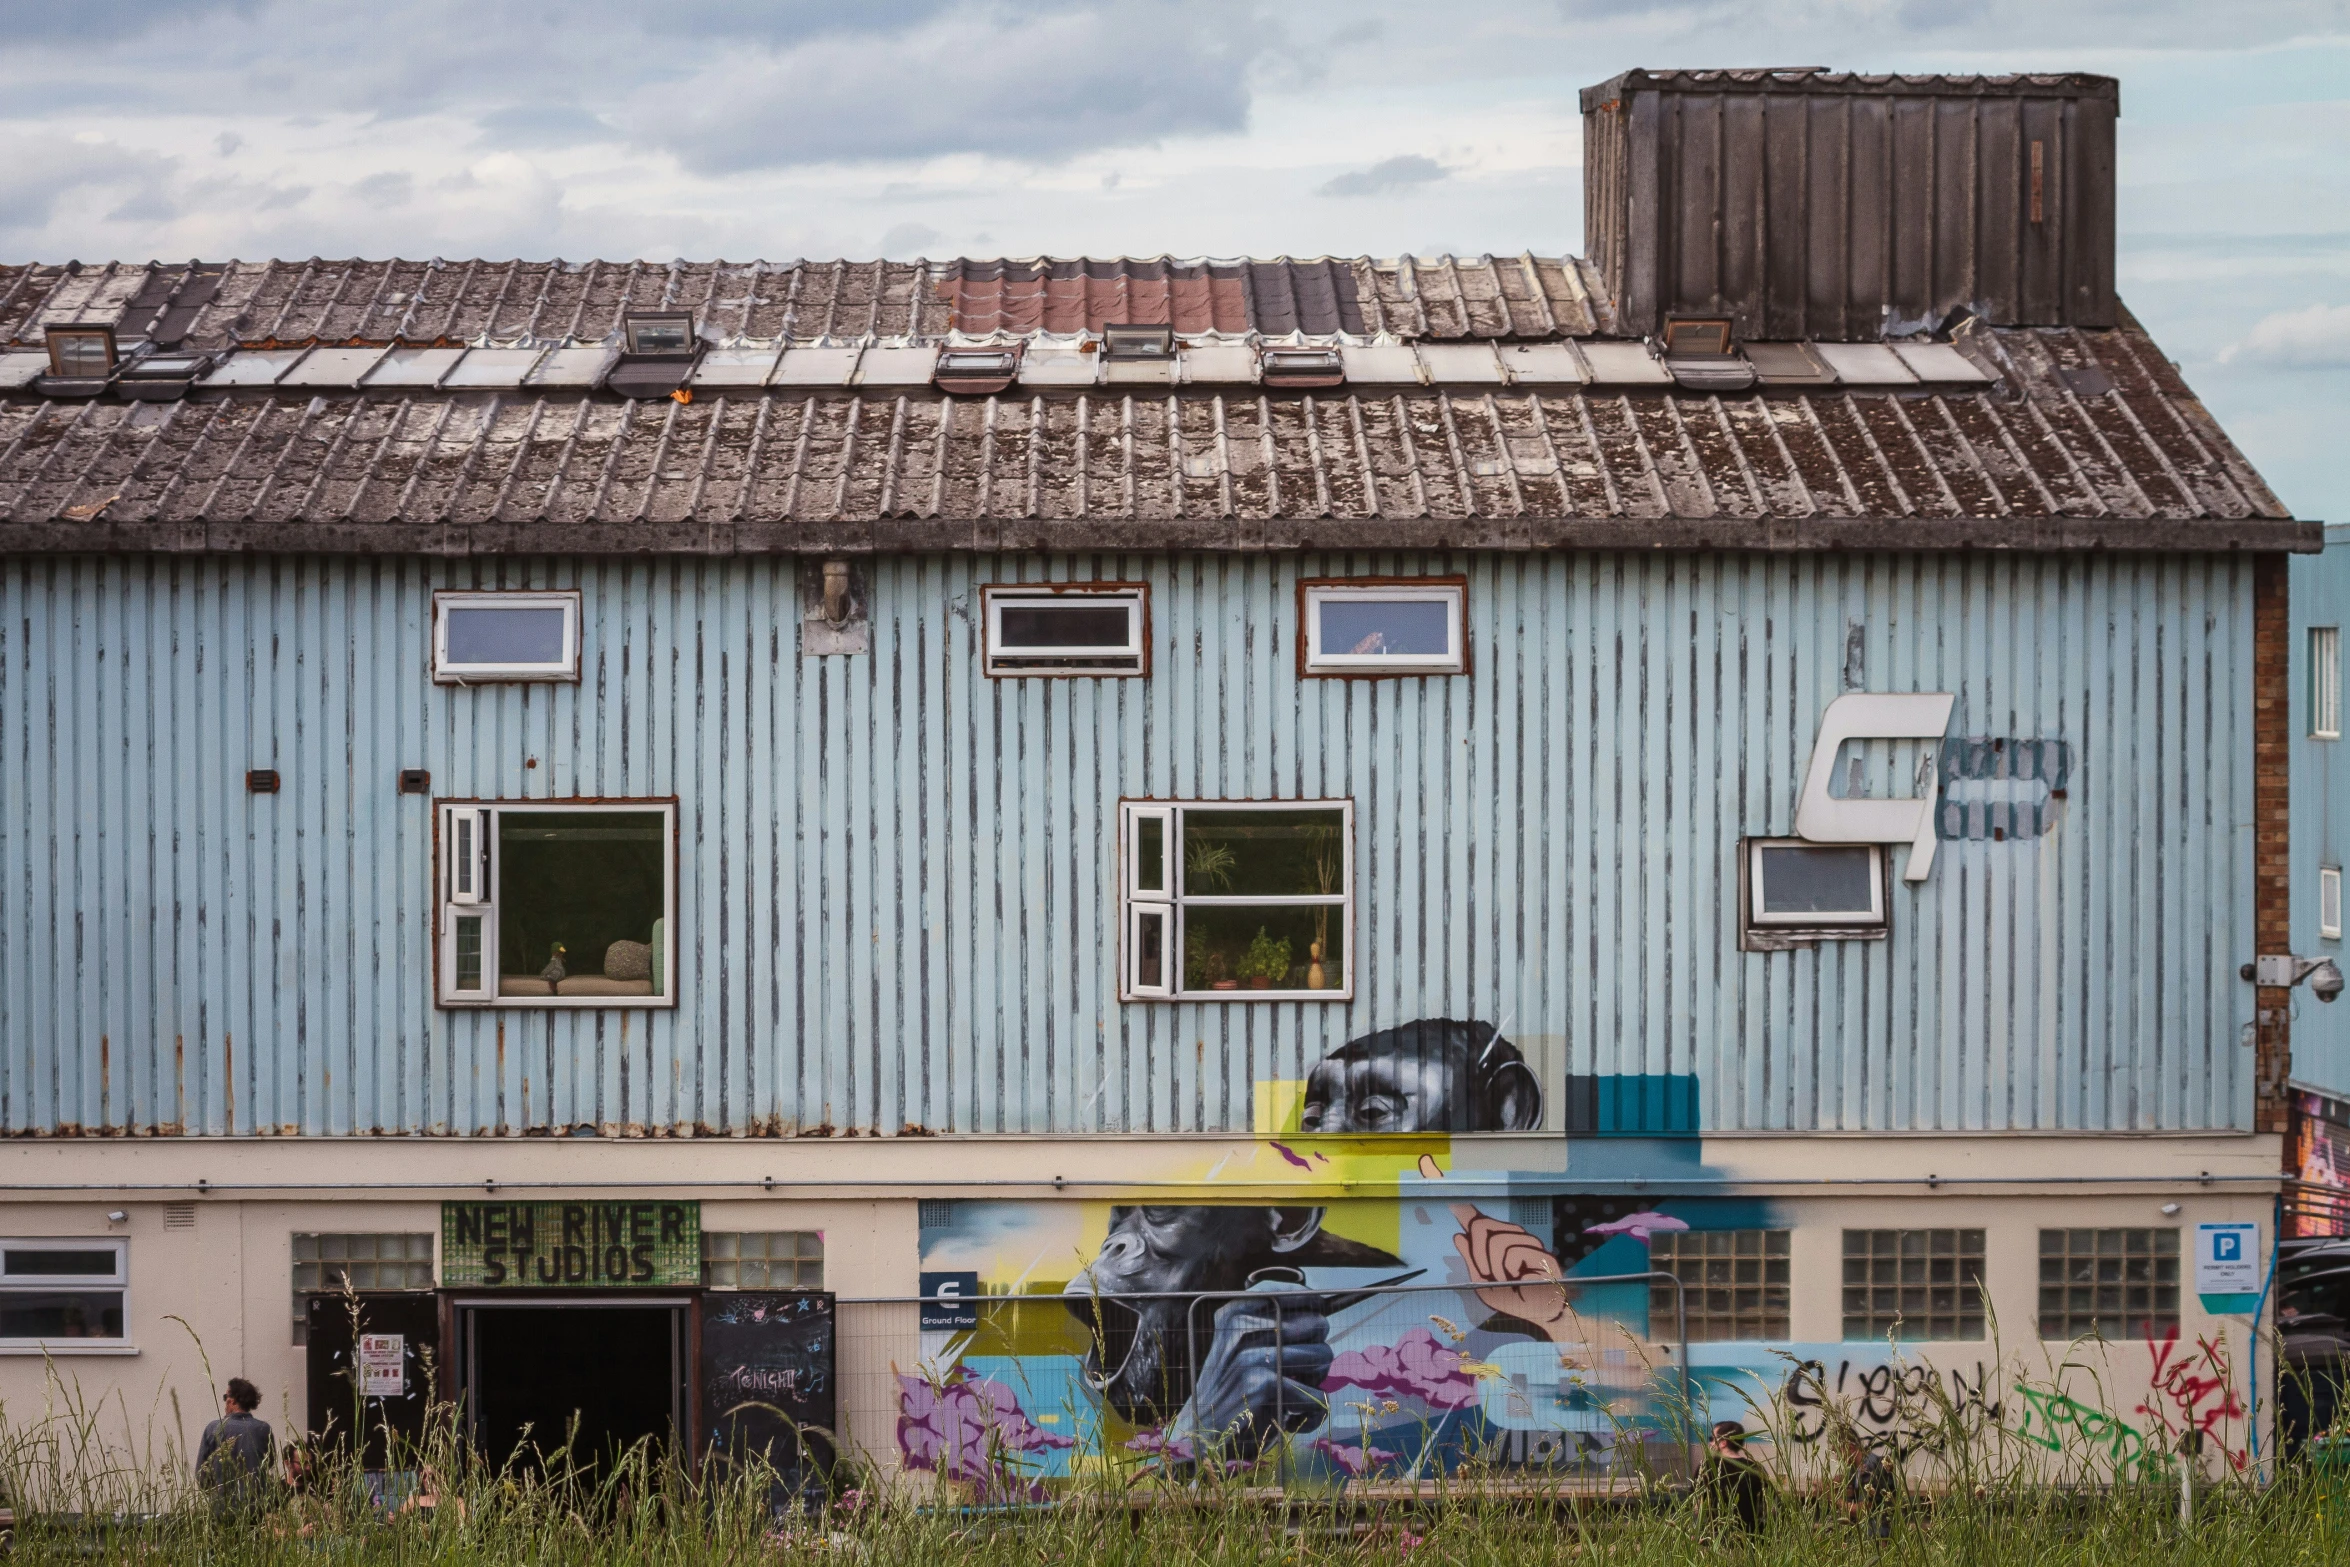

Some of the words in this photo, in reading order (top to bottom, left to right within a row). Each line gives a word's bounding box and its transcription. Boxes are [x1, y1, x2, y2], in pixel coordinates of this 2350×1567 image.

[455, 1205, 535, 1244] NEW
[563, 1204, 686, 1243] RIVER
[2220, 1237, 2236, 1257] P
[483, 1244, 656, 1284] STUDIOS
[922, 1316, 952, 1325] Ground
[954, 1316, 977, 1324] Floor
